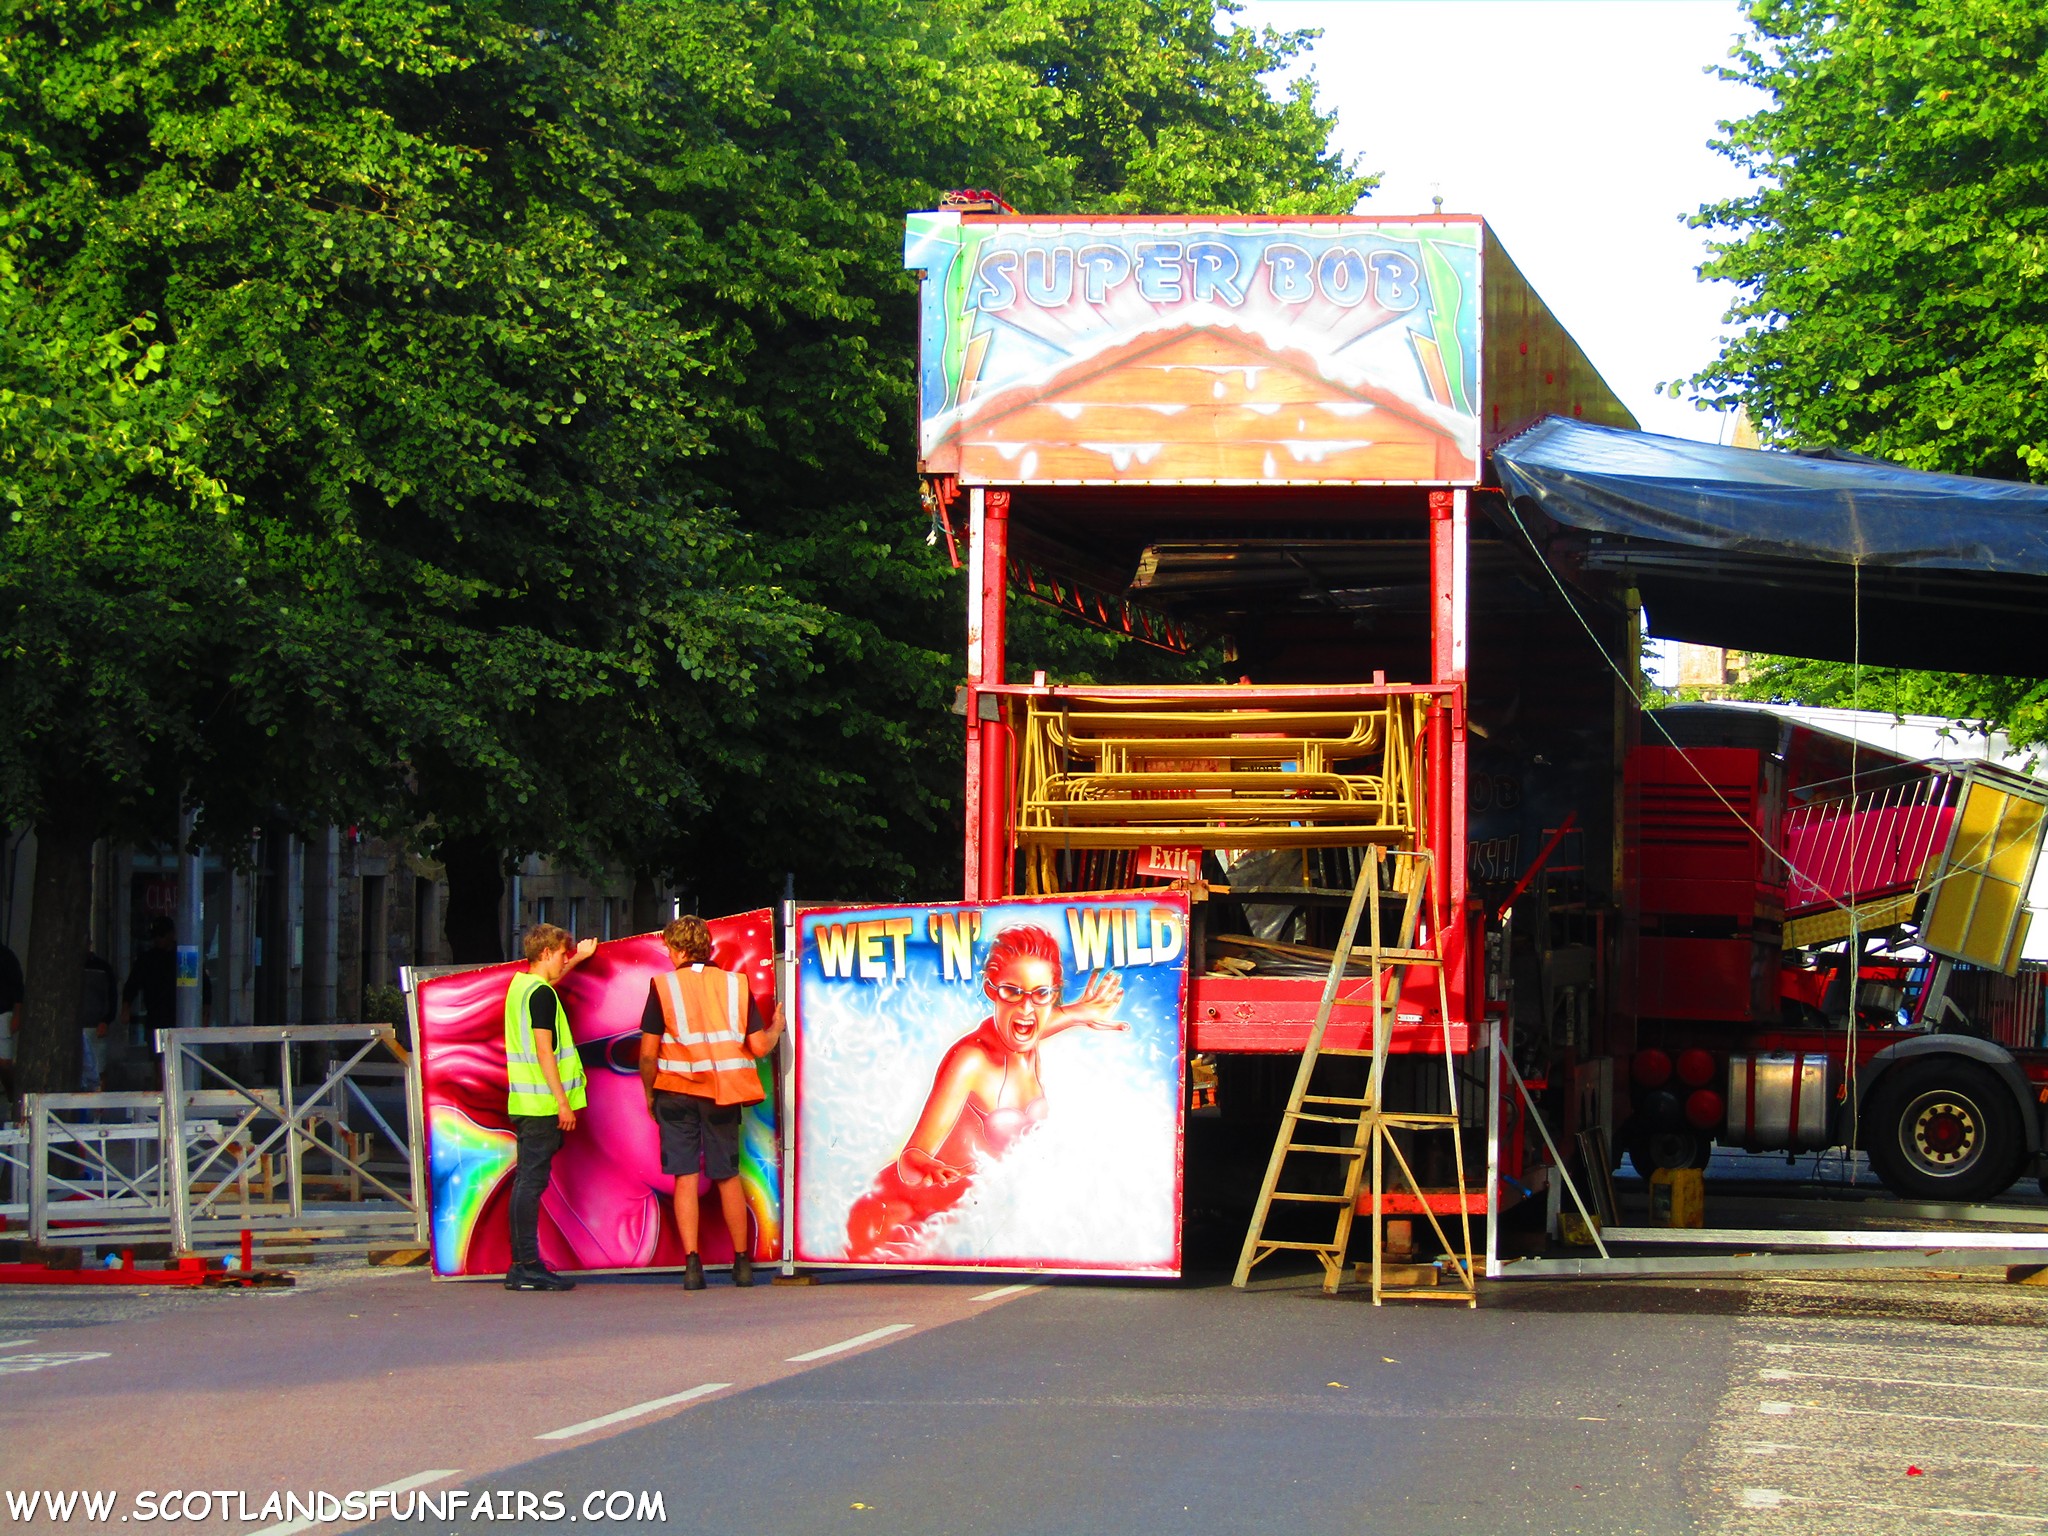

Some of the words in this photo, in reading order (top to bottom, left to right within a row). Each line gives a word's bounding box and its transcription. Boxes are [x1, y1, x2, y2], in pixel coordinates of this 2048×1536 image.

[977, 241, 1243, 312] SUPER
[1264, 243, 1421, 312] BOB
[1468, 770, 1521, 813] OB
[1148, 845, 1190, 872] Exit
[815, 917, 912, 981] WET
[1065, 907, 1183, 975] WILD
